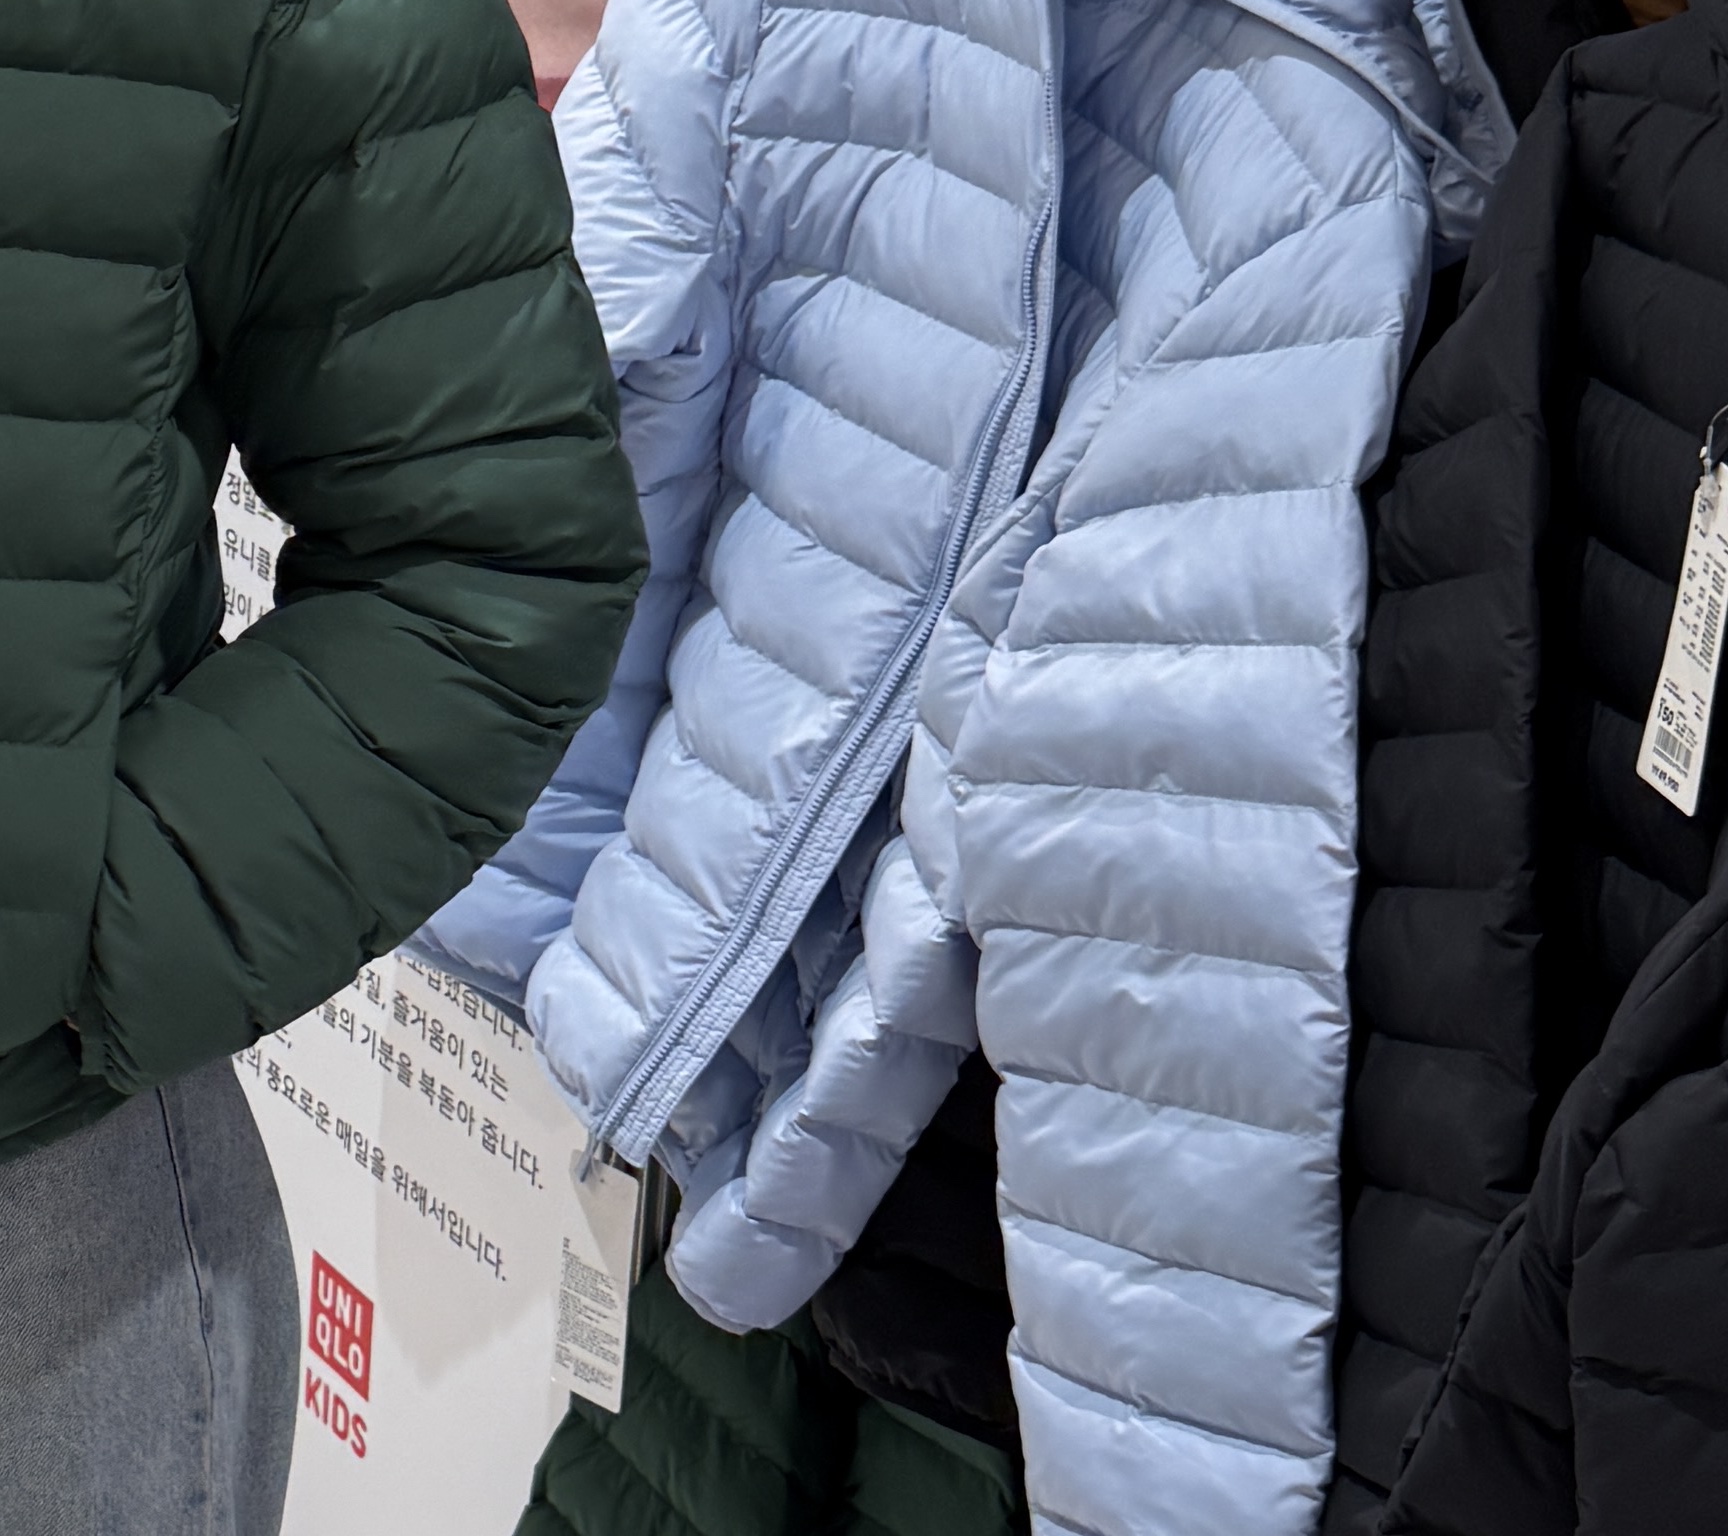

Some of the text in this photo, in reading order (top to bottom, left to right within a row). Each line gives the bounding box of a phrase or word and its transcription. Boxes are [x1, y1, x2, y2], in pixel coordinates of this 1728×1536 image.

[223, 528, 275, 581] 유니클
[393, 990, 465, 1070] 즐거움이
[471, 1049, 509, 1102] 있는
[360, 1024, 413, 1089] 기분을
[419, 1069, 476, 1137] 북돋아
[480, 1117, 544, 1190] 줍니다.
[236, 1047, 507, 1282] 의 풍요로운 매일을 위해서입니다.
[318, 1268, 365, 1327] UNI
[315, 1317, 365, 1379] QLO
[304, 1366, 369, 1460] KIDS
